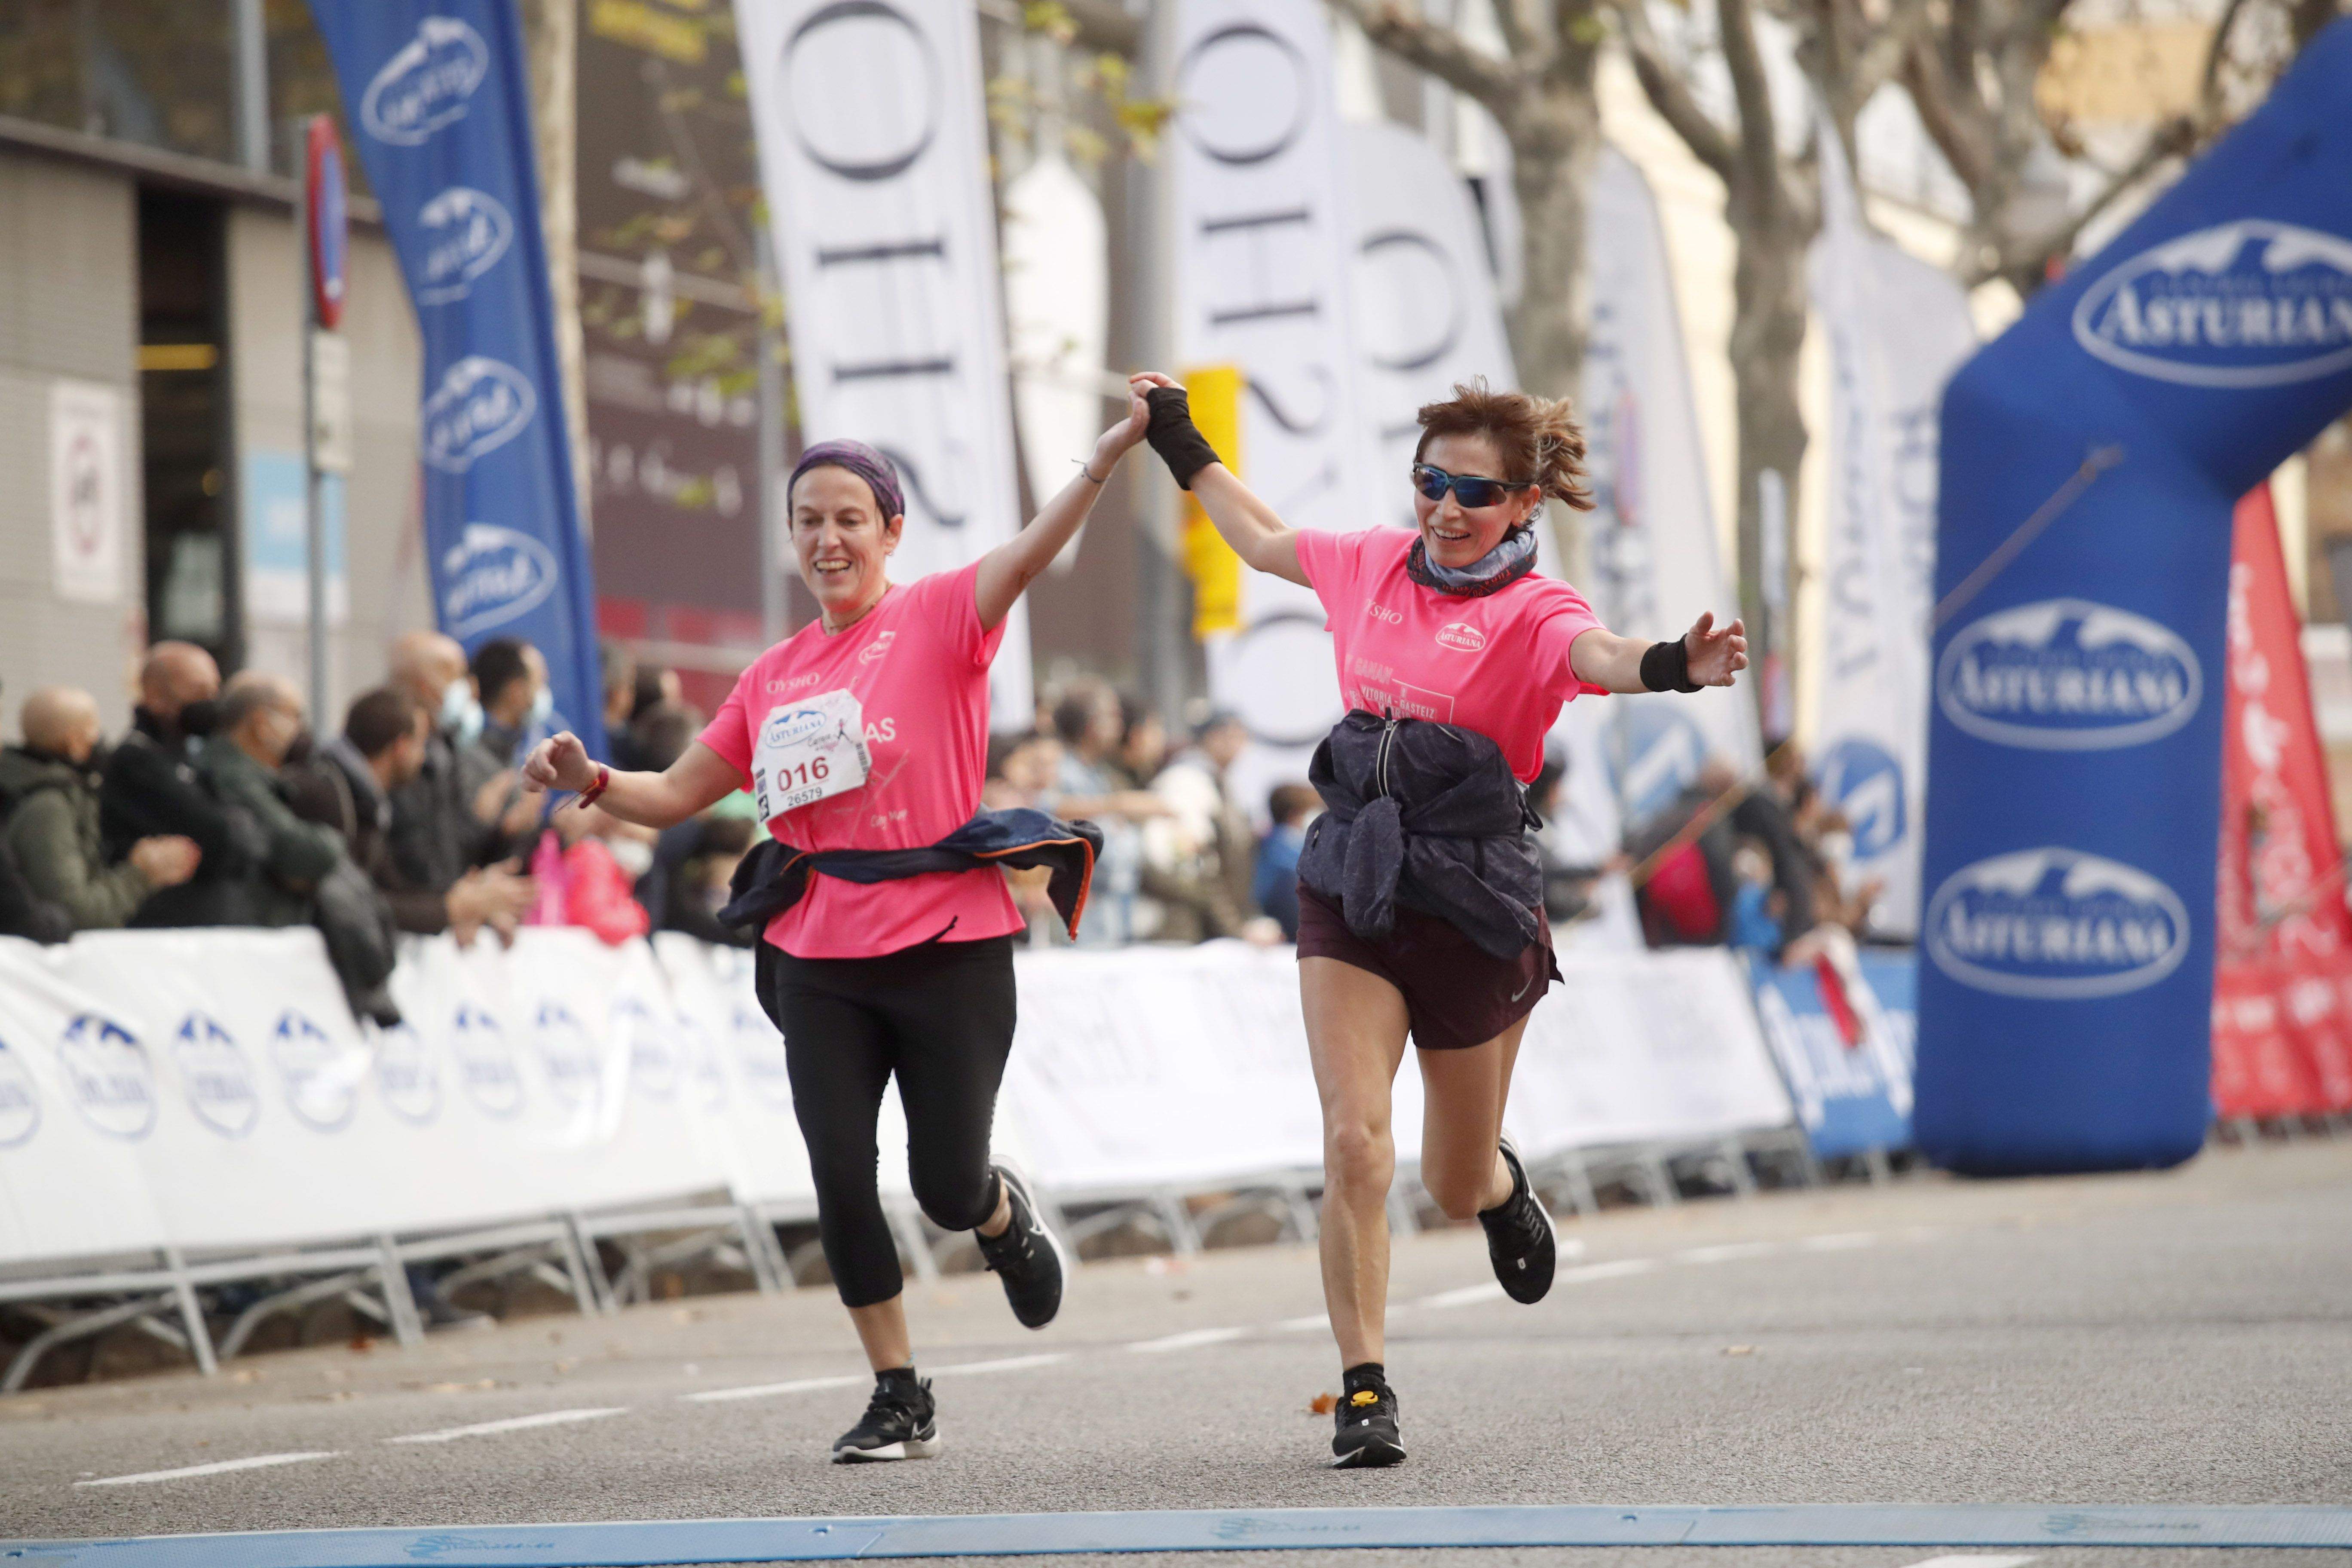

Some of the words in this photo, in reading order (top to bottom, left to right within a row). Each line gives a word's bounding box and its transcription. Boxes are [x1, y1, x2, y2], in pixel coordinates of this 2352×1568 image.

[2098, 282, 2352, 347] ASTURIAN
[1364, 598, 1403, 625] YSHO
[1440, 632, 1481, 648] ASTURIANA
[1378, 701, 1410, 719] MDRID
[770, 720, 821, 743] ASTURIANA
[864, 717, 896, 744] AS
[778, 756, 829, 792] 016
[787, 787, 823, 807] 26579
